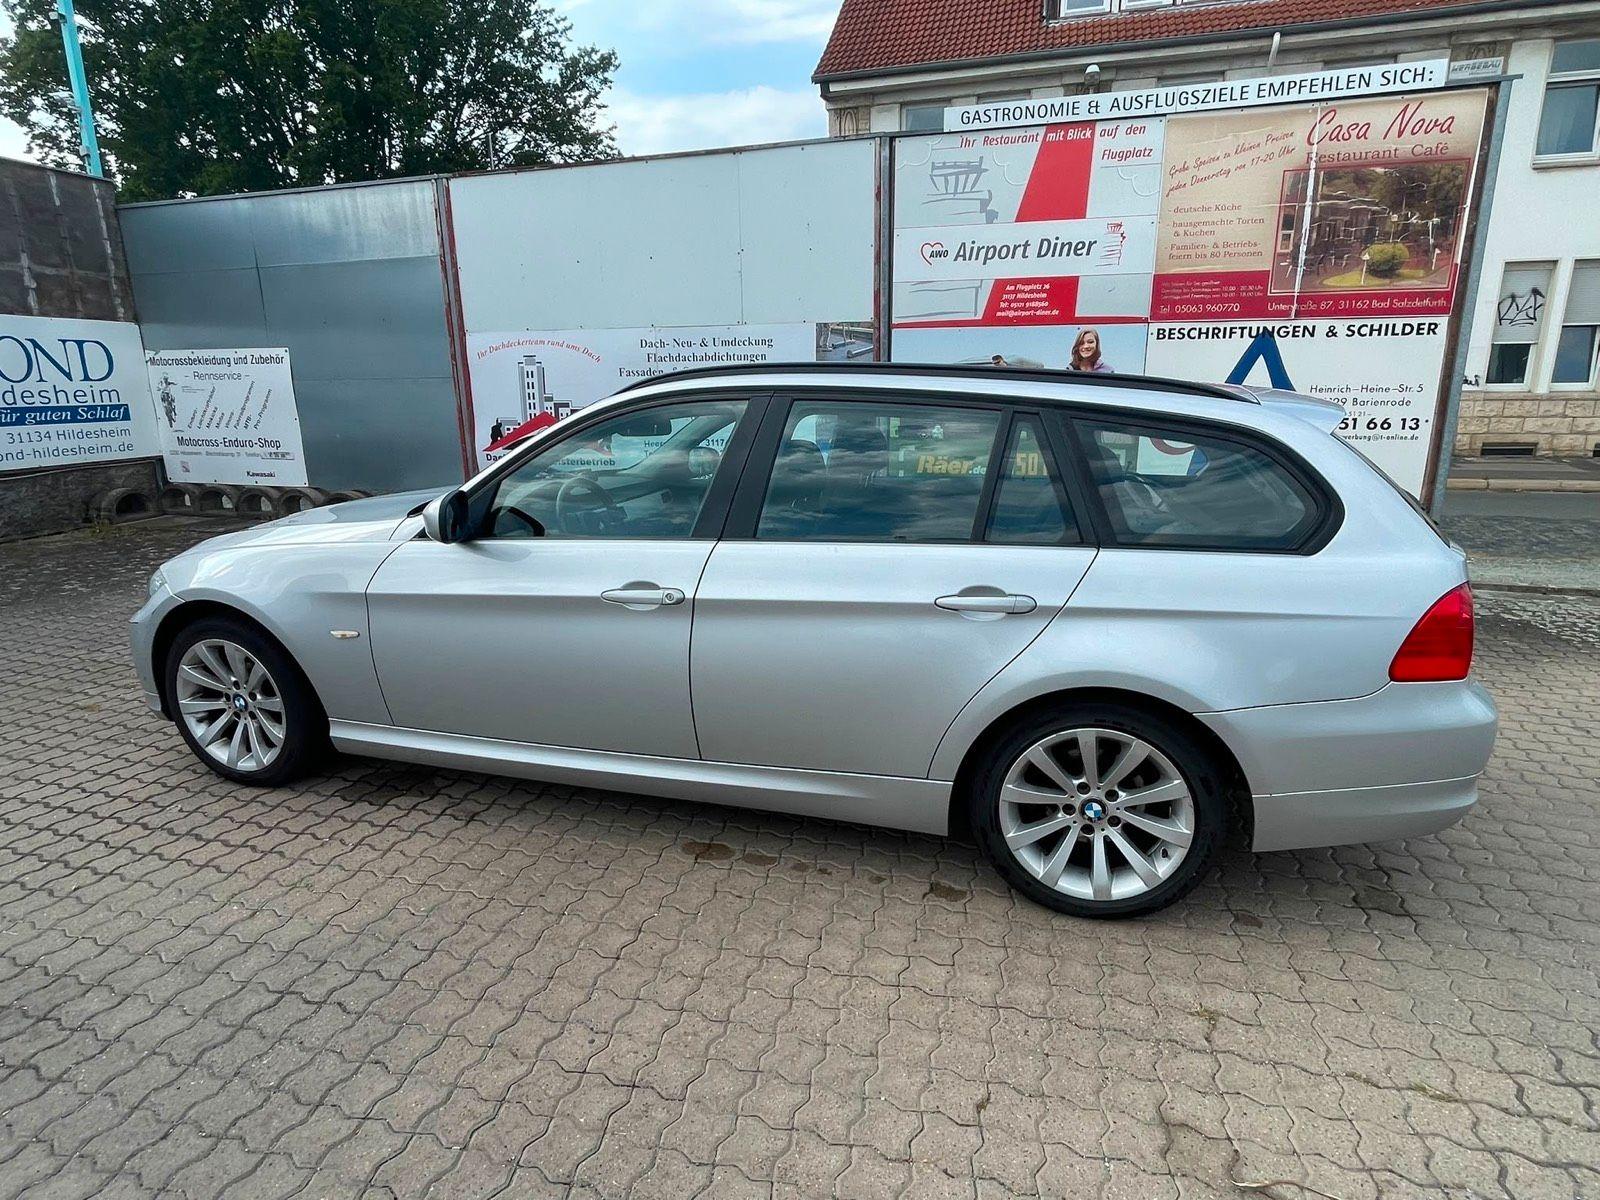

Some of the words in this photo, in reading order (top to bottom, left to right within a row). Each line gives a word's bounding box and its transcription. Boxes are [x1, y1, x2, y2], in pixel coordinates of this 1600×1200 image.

[960, 101, 1080, 125] GASTRONOMIE
[1087, 101, 1101, 115] &
[1109, 84, 1250, 112] AUSFLUGSZIELE
[1256, 73, 1371, 99] EMPFEHLEN
[1380, 66, 1434, 86] SICH:
[1306, 108, 1371, 147] Casa
[1382, 100, 1456, 141] Nova
[960, 135, 977, 149] Ihr
[982, 132, 1040, 147] Restaurant
[1046, 130, 1064, 143] mit
[1067, 128, 1093, 141] Blick
[1099, 123, 1119, 139] auf
[1125, 123, 1146, 136] den
[1101, 145, 1154, 162] Flugplatz
[1305, 147, 1400, 165] Restaurant
[1411, 142, 1450, 158] Café
[1173, 203, 1212, 213] deutsche
[1172, 219, 1234, 229] hausgemachte
[1183, 229, 1216, 238] Kuchen
[929, 249, 949, 260] AWO
[953, 240, 1031, 265] Airport
[1036, 236, 1098, 259] Diner
[1195, 251, 1208, 260] bis
[1210, 250, 1221, 259] 80
[1223, 249, 1264, 258] Personen
[1175, 304, 1203, 314] 05063
[1206, 303, 1240, 313] 960770
[1320, 301, 1334, 311] 87,
[1338, 299, 1369, 310] 31162
[1372, 300, 1388, 308] Bad
[1392, 298, 1447, 308] Salzdetfurth
[1156, 326, 1316, 339] BESCHRIFTUNGEN
[1326, 326, 1338, 338] &
[1345, 322, 1439, 337] SCHILDER
[640, 338, 670, 348] Dach-
[673, 338, 697, 347] Neu-
[700, 338, 708, 347] &
[713, 337, 773, 347] Umdeckung
[476, 351, 488, 359] Ihr
[489, 339, 545, 353] Dachdeckerteam
[566, 344, 580, 352] ums
[582, 347, 601, 363] Dach
[647, 352, 767, 362] Flachdachabdichtungen
[0, 335, 114, 383] OND
[149, 356, 231, 367] Motocrossbekleidung
[233, 356, 248, 365] und
[250, 354, 284, 365] Zubehör
[193, 371, 241, 380] Rennservice
[1416, 383, 1424, 393] 5
[1352, 397, 1411, 406] Barienrode
[25, 409, 71, 425] guten
[77, 405, 127, 421] Schlaf
[1338, 417, 1358, 430] 51
[1366, 418, 1392, 430] 66
[1400, 418, 1420, 430] 13
[6, 431, 52, 444] 31134
[56, 428, 131, 440] Hildesheim
[177, 436, 281, 449] Motocross-Enduro-Shop
